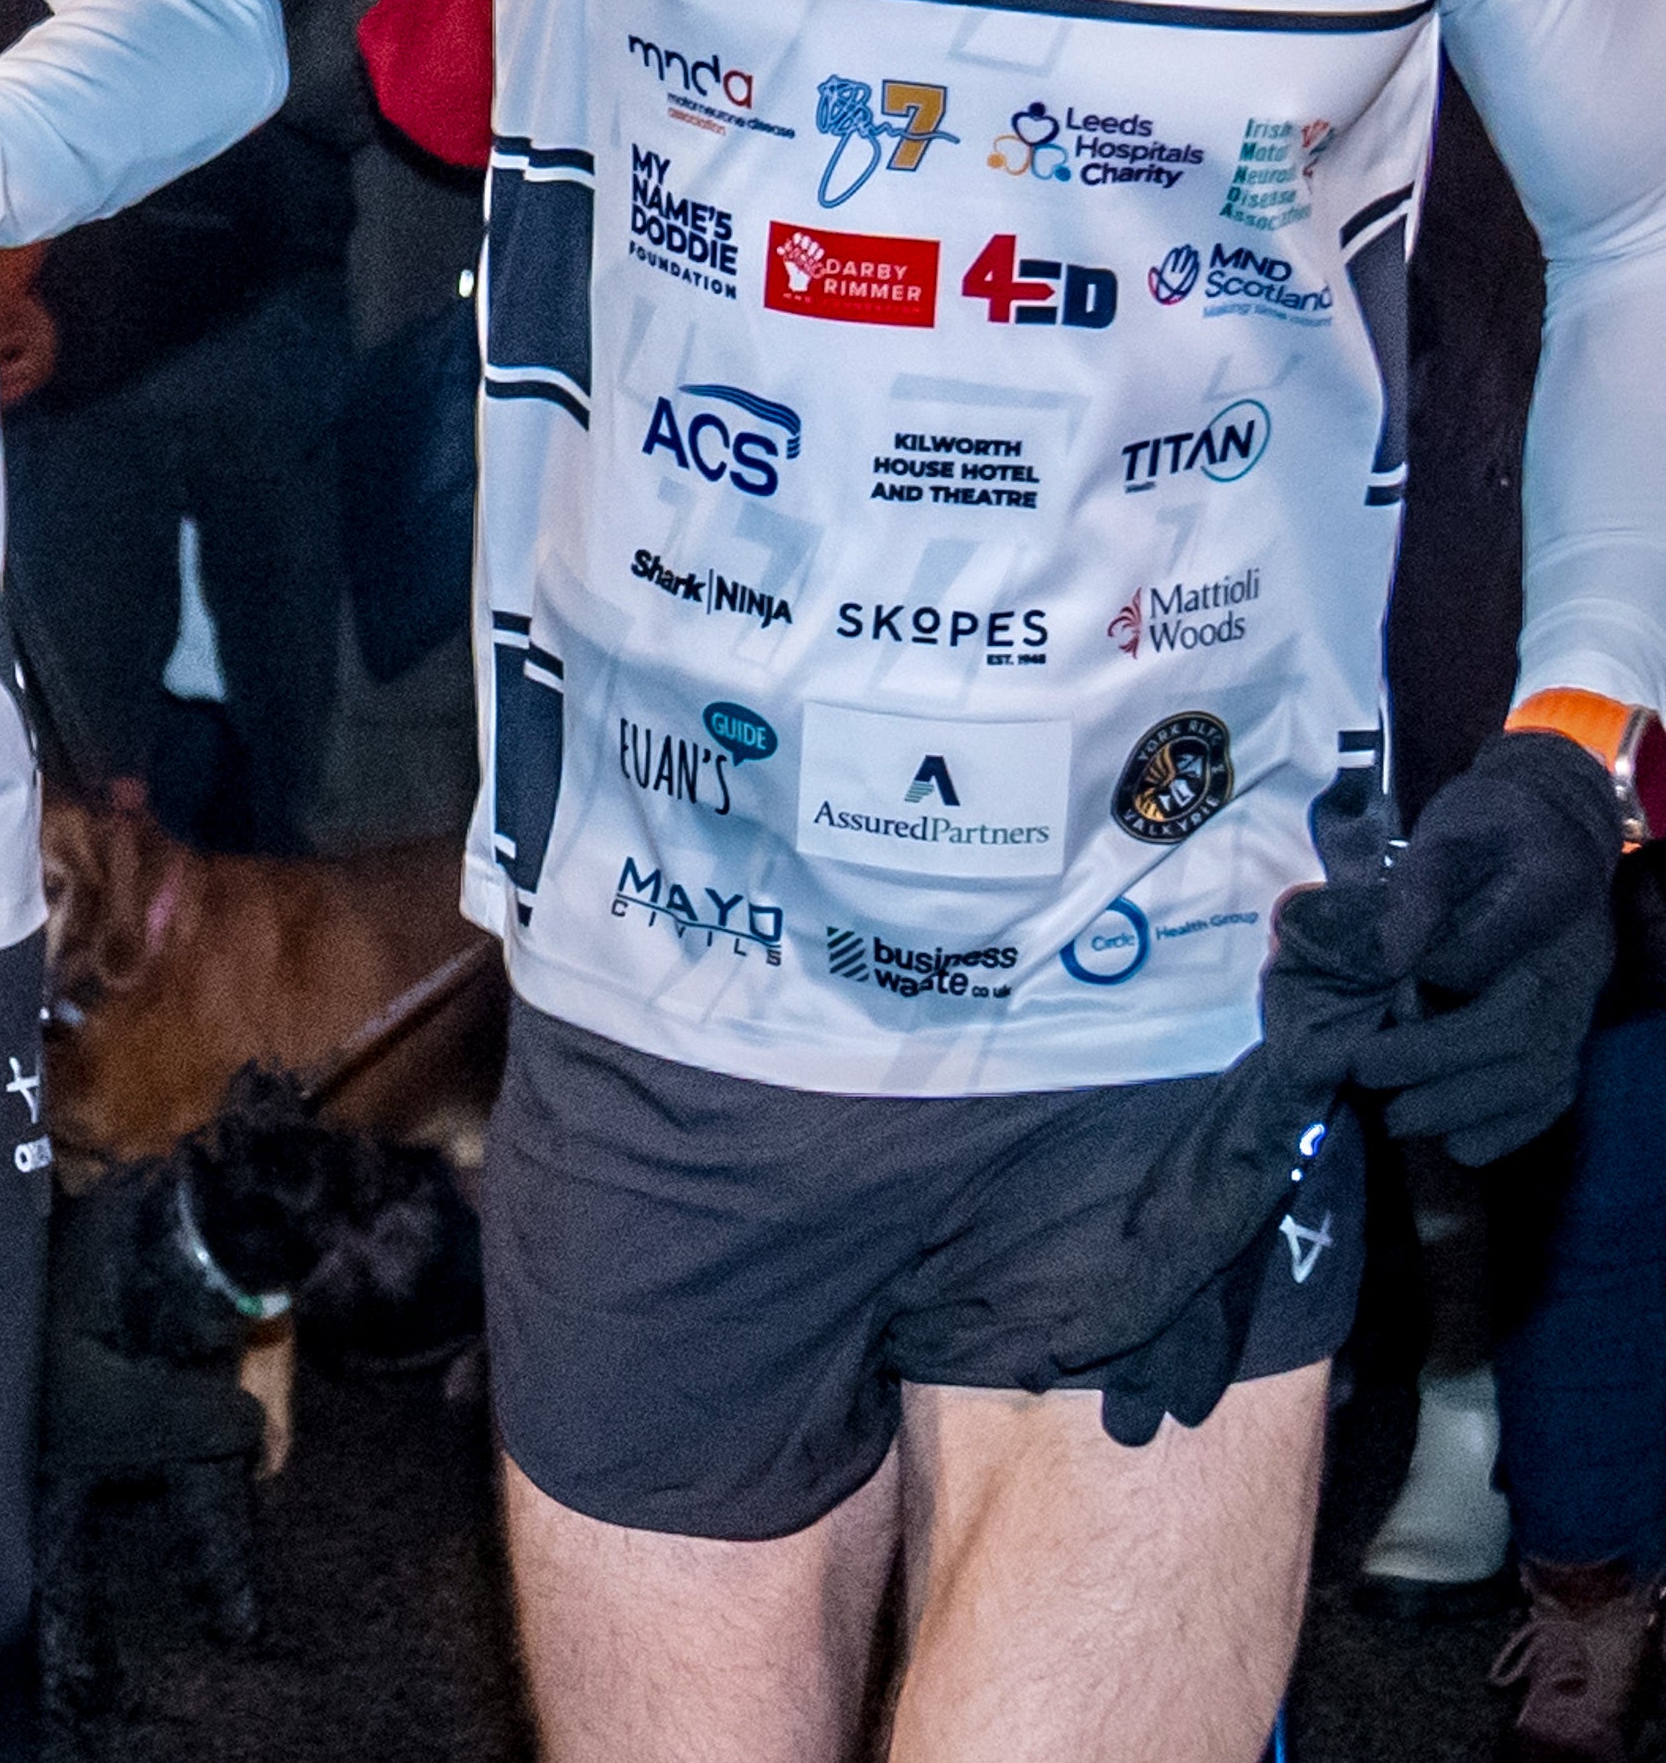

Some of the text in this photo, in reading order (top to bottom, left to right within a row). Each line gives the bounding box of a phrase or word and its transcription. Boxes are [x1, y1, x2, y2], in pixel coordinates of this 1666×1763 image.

[629, 35, 753, 110] mnda
[882, 79, 948, 172] 7
[1067, 108, 1153, 138] Leeds
[632, 143, 670, 184] MY
[1075, 136, 1204, 167] Hospitals
[1080, 163, 1183, 188] Charity
[632, 179, 733, 241] NAME'S
[631, 205, 738, 276] DODDIE
[629, 240, 737, 300] FOUNDATION
[826, 258, 908, 281] DARBY
[1210, 243, 1292, 282] MND
[823, 277, 922, 302] RIMMER
[642, 396, 780, 497] ACS
[894, 432, 1022, 458] KILWORTH
[1121, 420, 1256, 482] TITAN
[873, 456, 1040, 485] HOUSE HOTEL
[870, 482, 1038, 509] AND THEATRE
[1149, 569, 1260, 620] Mattioli
[836, 602, 1049, 648] SKOPES
[1149, 610, 1246, 653] Woods
[710, 712, 768, 751] GUIDE
[619, 717, 732, 816] EUAN'S
[814, 800, 1050, 845] AssuredPartners
[616, 857, 784, 946] MAYO
[873, 936, 1019, 974] business
